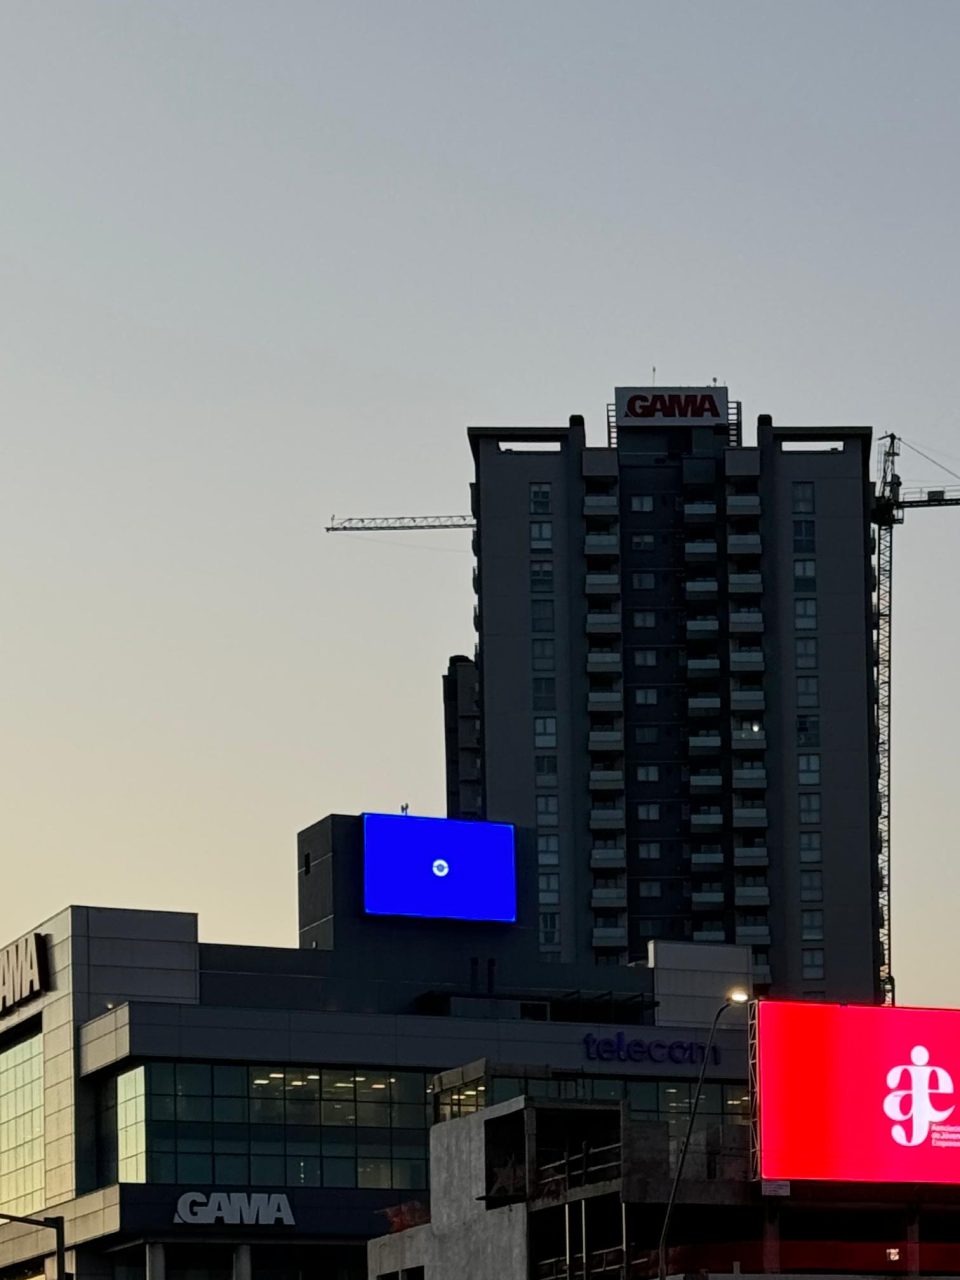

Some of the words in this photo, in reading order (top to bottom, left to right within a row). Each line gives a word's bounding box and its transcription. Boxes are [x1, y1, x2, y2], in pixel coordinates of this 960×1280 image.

[624, 393, 721, 418] GAMA
[583, 1031, 721, 1065] telecom
[173, 1191, 296, 1226] GAMA
